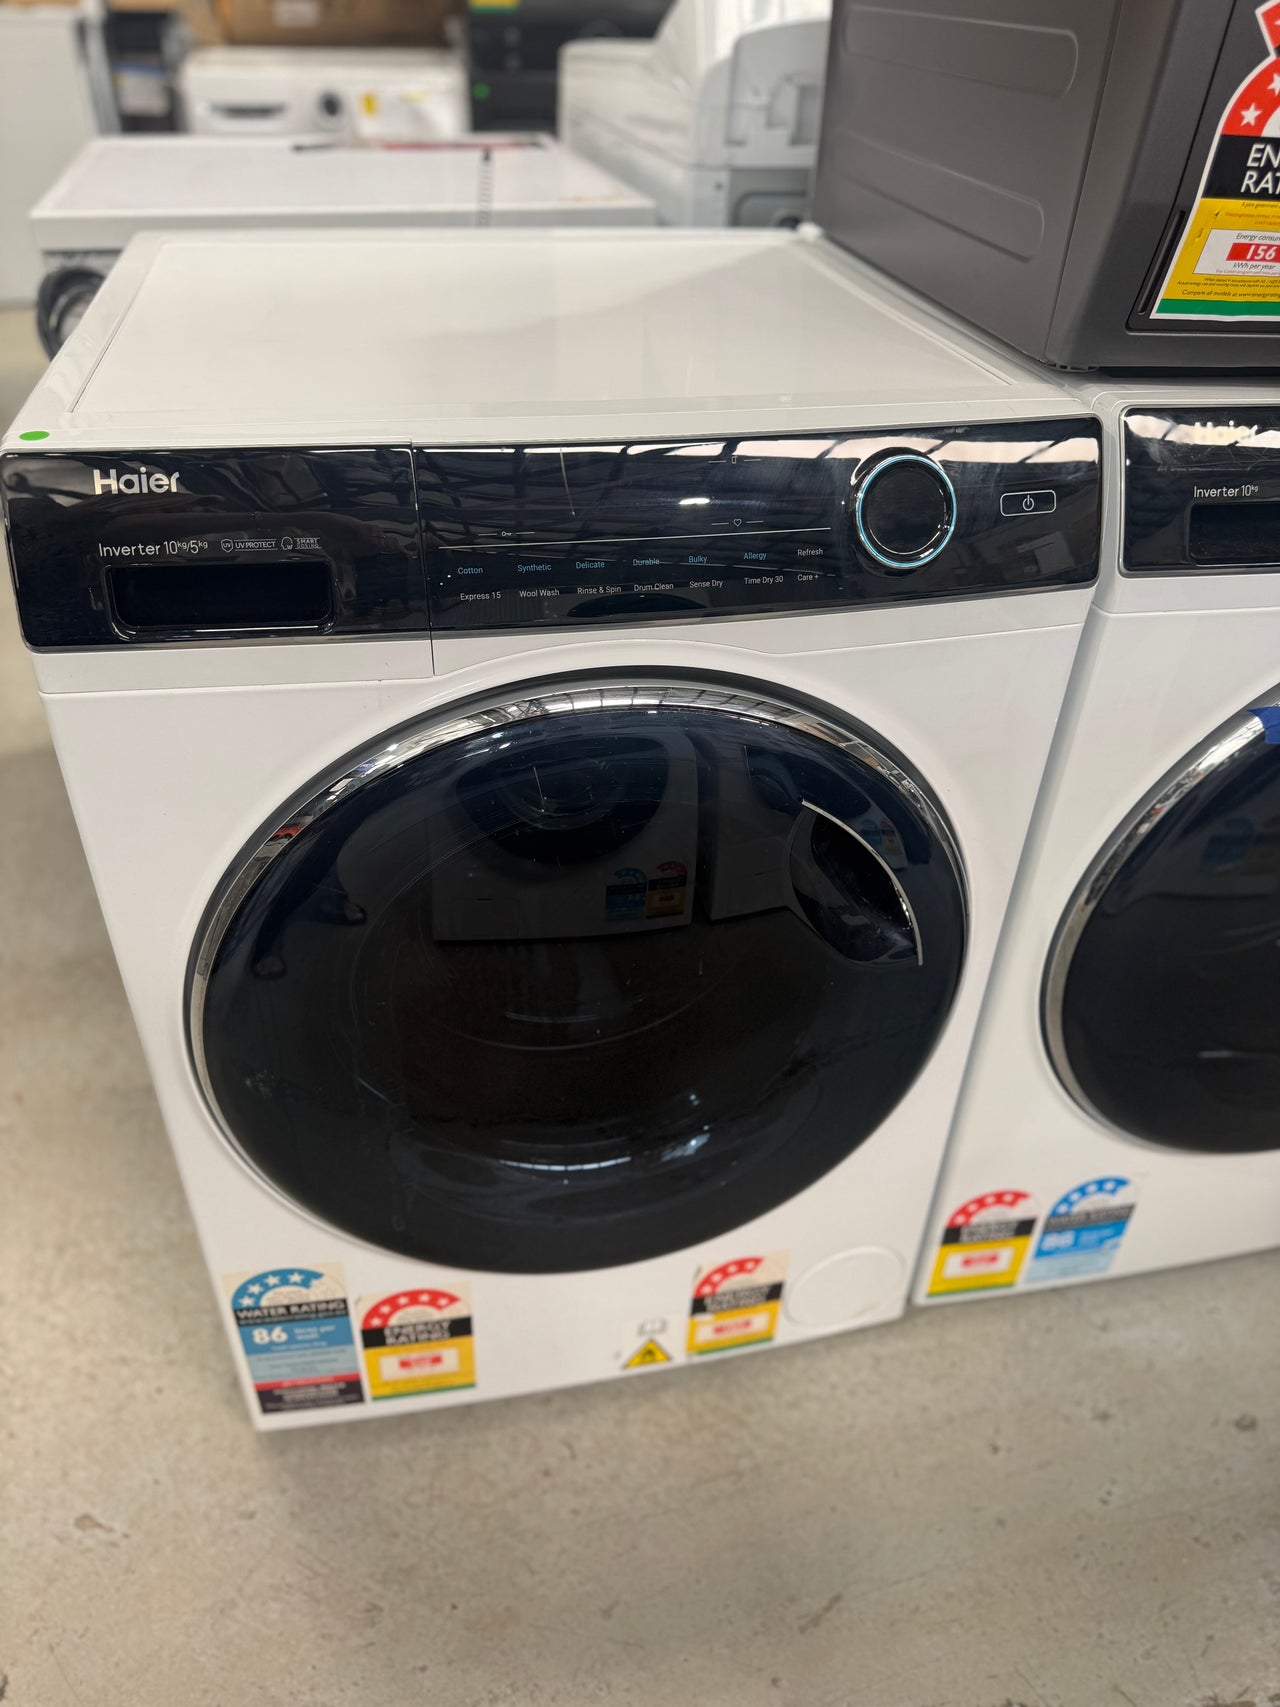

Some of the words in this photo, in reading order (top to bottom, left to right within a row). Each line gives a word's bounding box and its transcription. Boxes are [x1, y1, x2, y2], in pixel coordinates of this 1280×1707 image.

[1235, 232, 1257, 242] Energy
[1245, 244, 1278, 261] 156
[1260, 264, 1276, 272] year
[93, 466, 180, 495] Haier
[1193, 486, 1239, 498] Inverter
[1241, 484, 1259, 497] 10kg
[98, 543, 161, 557] Inverter
[798, 548, 824, 556] Refresh
[688, 555, 708, 564] Bulky
[744, 552, 767, 561] Allergy
[576, 561, 605, 569] Delicate
[632, 558, 660, 566] Durable
[457, 567, 483, 575] Cotton
[517, 564, 552, 573] Synthetic
[744, 576, 761, 585] Time
[762, 576, 774, 584] Dry
[775, 575, 784, 583] 30
[797, 574, 813, 582] Care
[634, 584, 653, 592] Drum
[654, 582, 674, 590] Clean
[689, 580, 710, 588] Sense
[711, 579, 724, 588] Dry
[519, 590, 538, 598] Wool
[540, 588, 560, 596] Wash
[577, 586, 597, 595] Rinse
[606, 586, 622, 594] Spin
[460, 593, 490, 601] Express
[236, 1307, 287, 1318] WATER
[289, 1301, 346, 1314] RATING
[252, 1326, 289, 1345] 86
